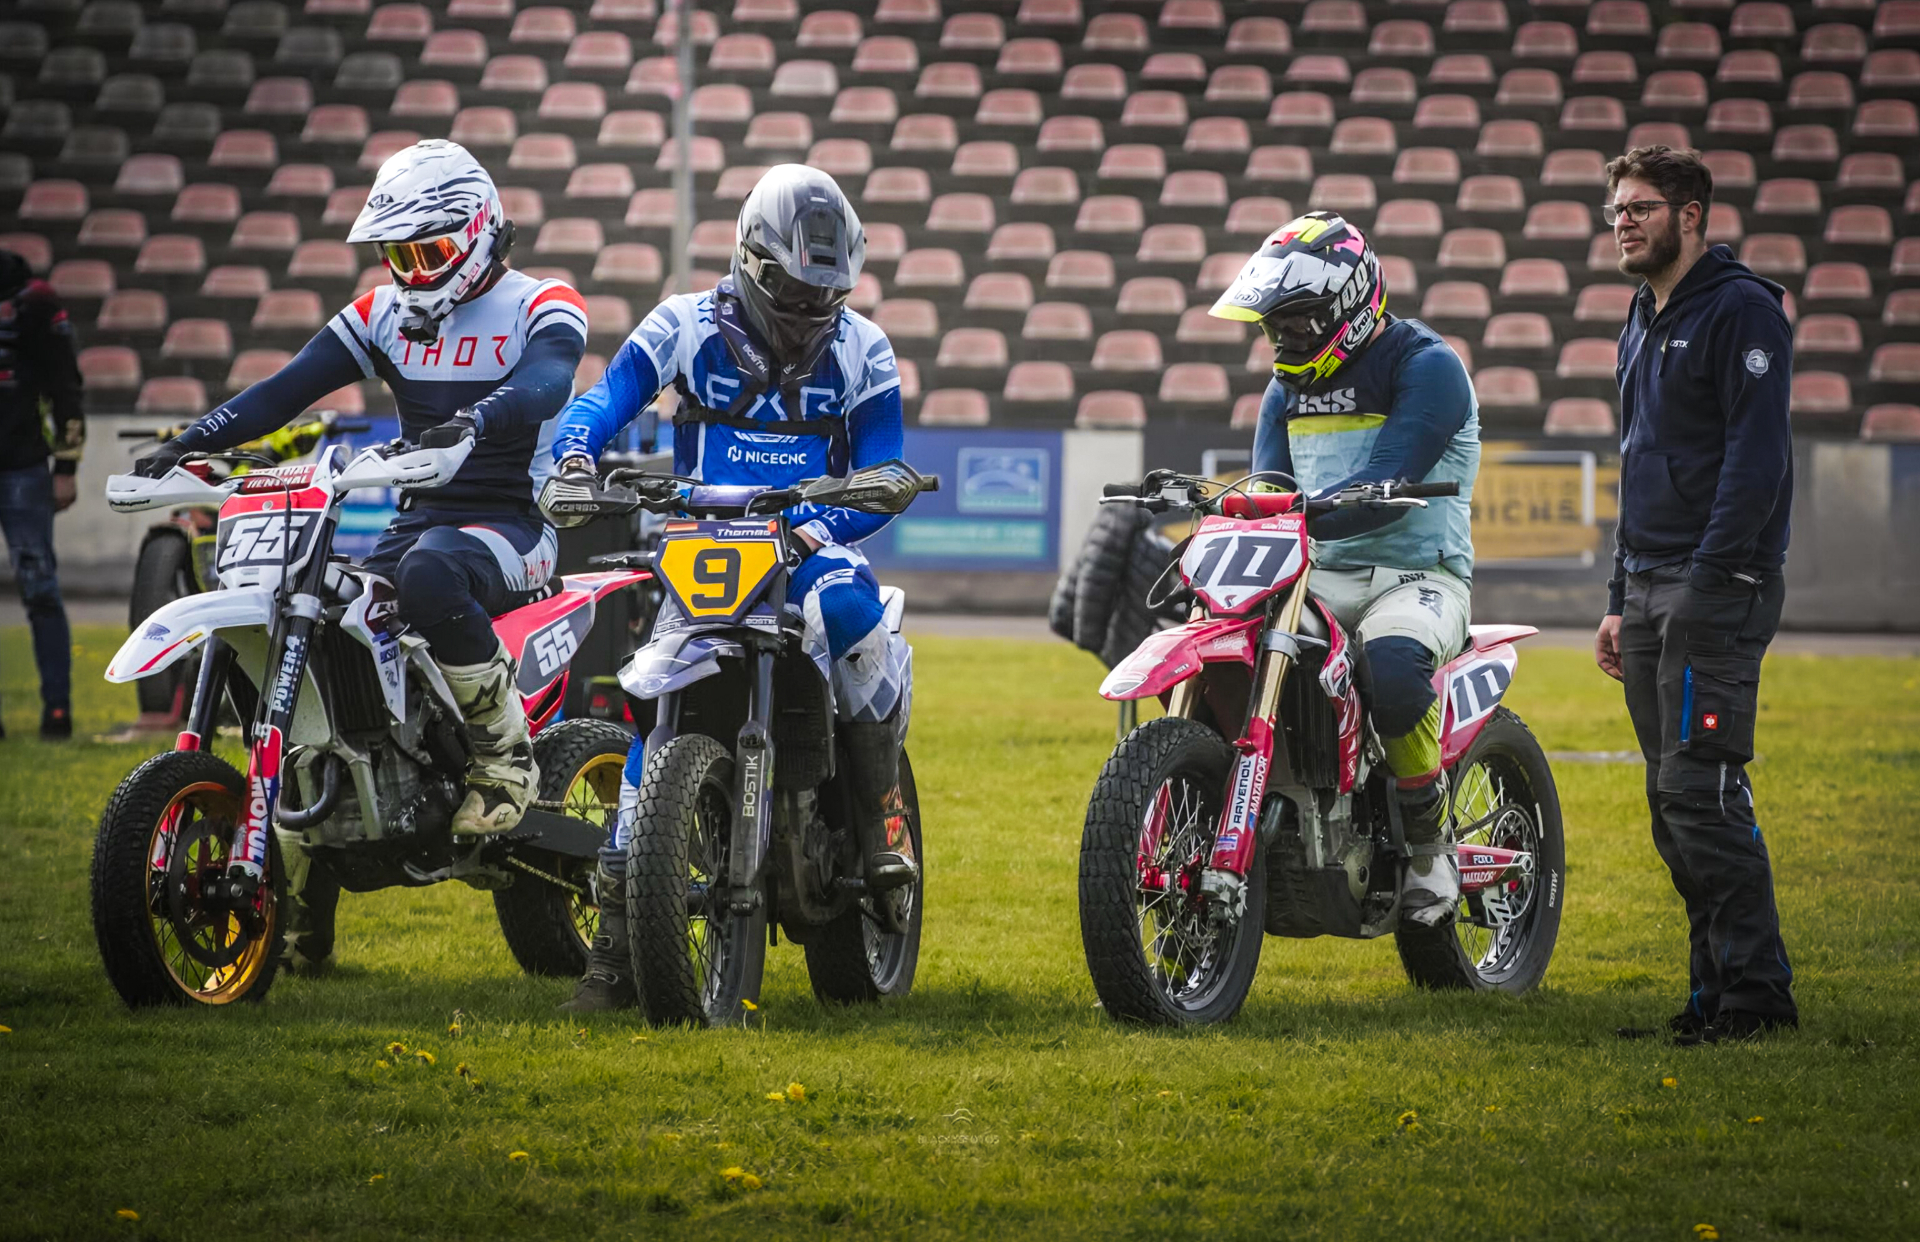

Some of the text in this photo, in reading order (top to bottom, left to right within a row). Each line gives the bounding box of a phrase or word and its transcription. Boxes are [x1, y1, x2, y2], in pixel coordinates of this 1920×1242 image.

[745, 451, 808, 465] NICECNC
[219, 515, 308, 568] 55
[1194, 535, 1299, 588] 10
[691, 548, 741, 608] 9
[533, 619, 578, 677] 55
[1453, 660, 1511, 722] 10
[742, 754, 758, 817] BOSTIK
[1233, 760, 1252, 823] RAVENOL
[1249, 755, 1268, 815] MATADOR
[247, 776, 272, 866] MOTUL
